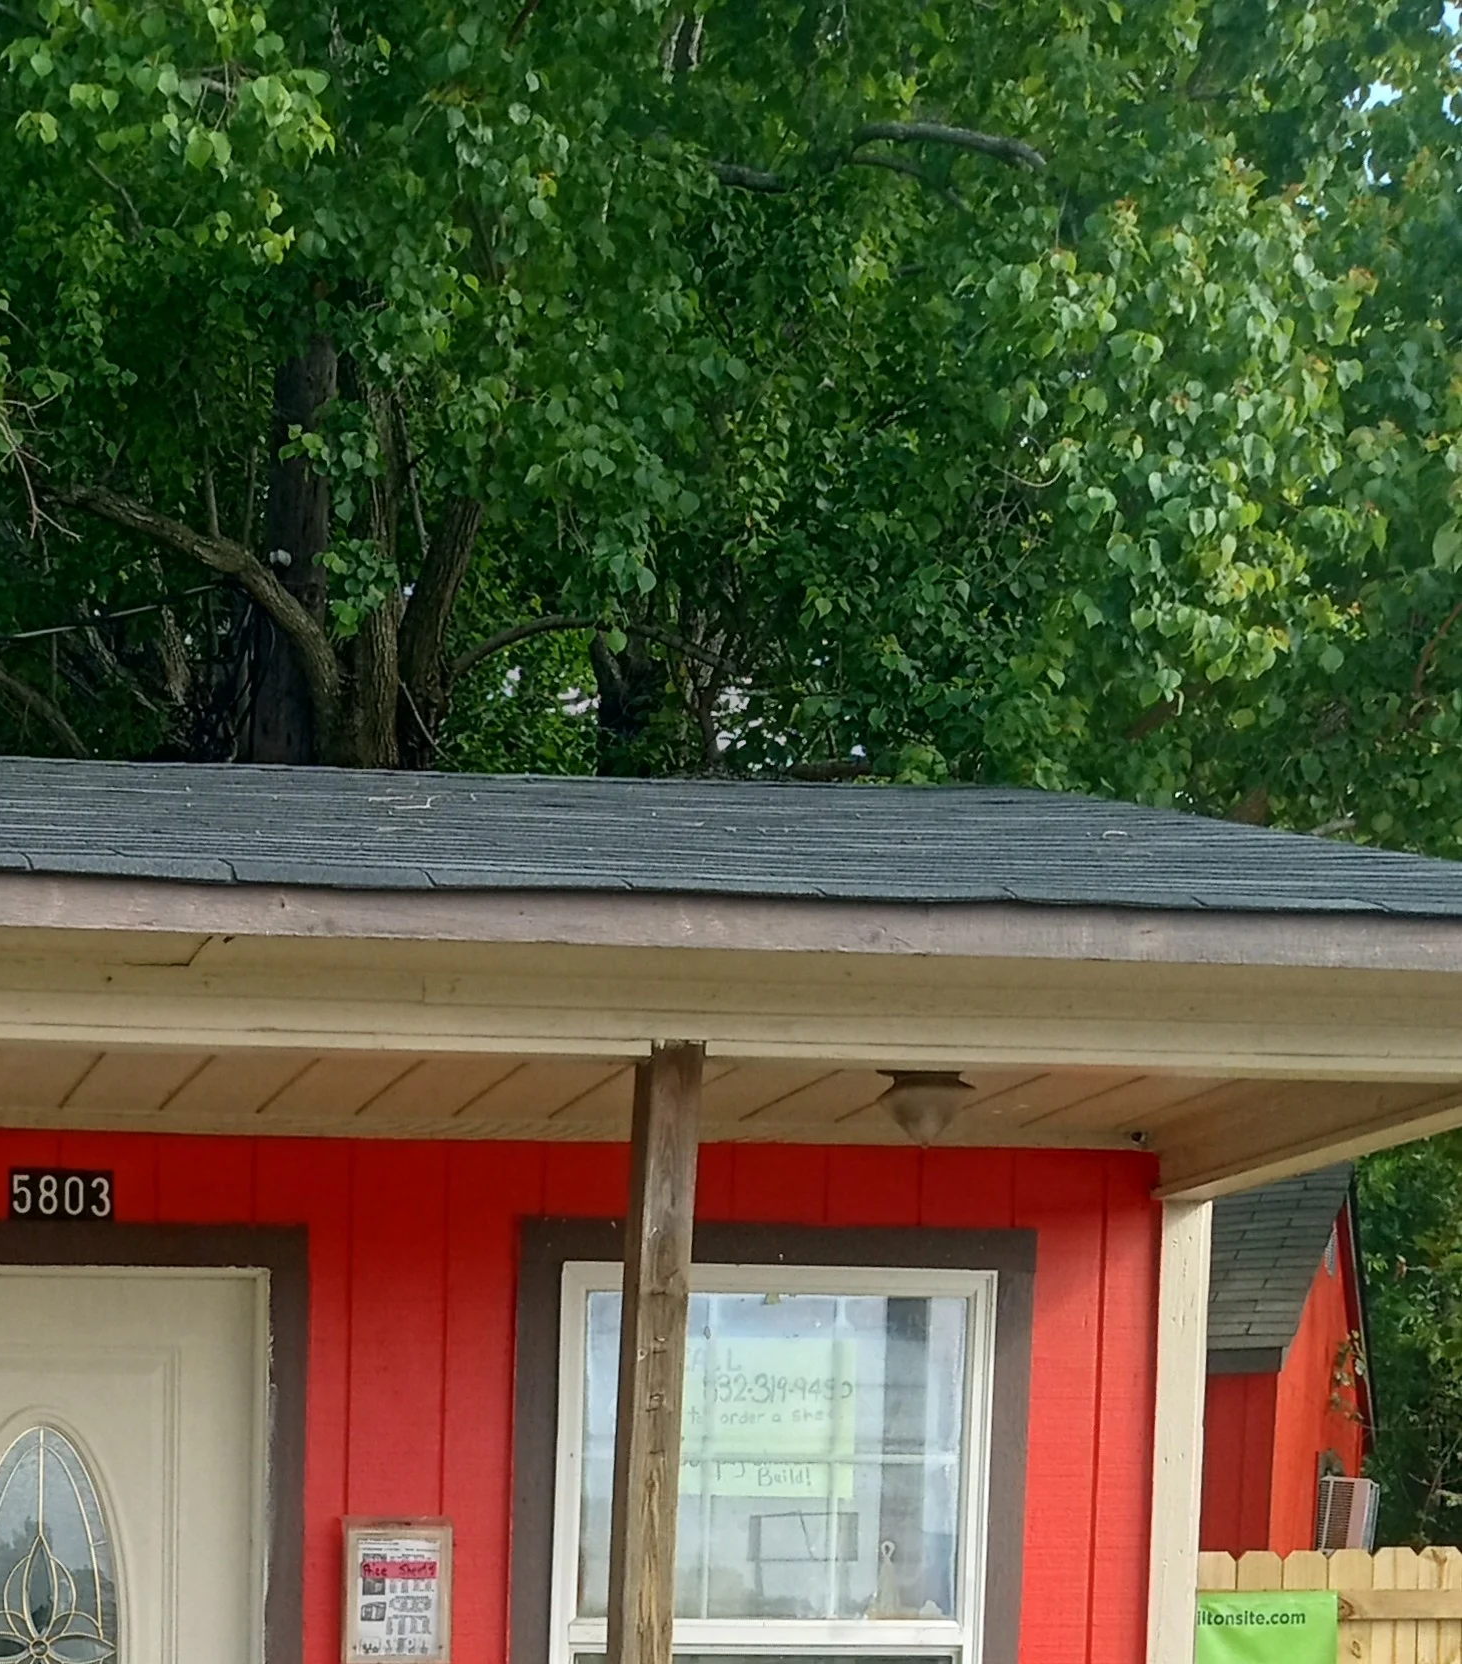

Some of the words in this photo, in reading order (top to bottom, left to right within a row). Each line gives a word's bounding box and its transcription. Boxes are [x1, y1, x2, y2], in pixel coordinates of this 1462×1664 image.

[13, 1174, 111, 1217] 5803
[720, 1406, 765, 1425] order
[757, 1466, 812, 1488] Build!
[1196, 1610, 1306, 1626] iltonsite.com
